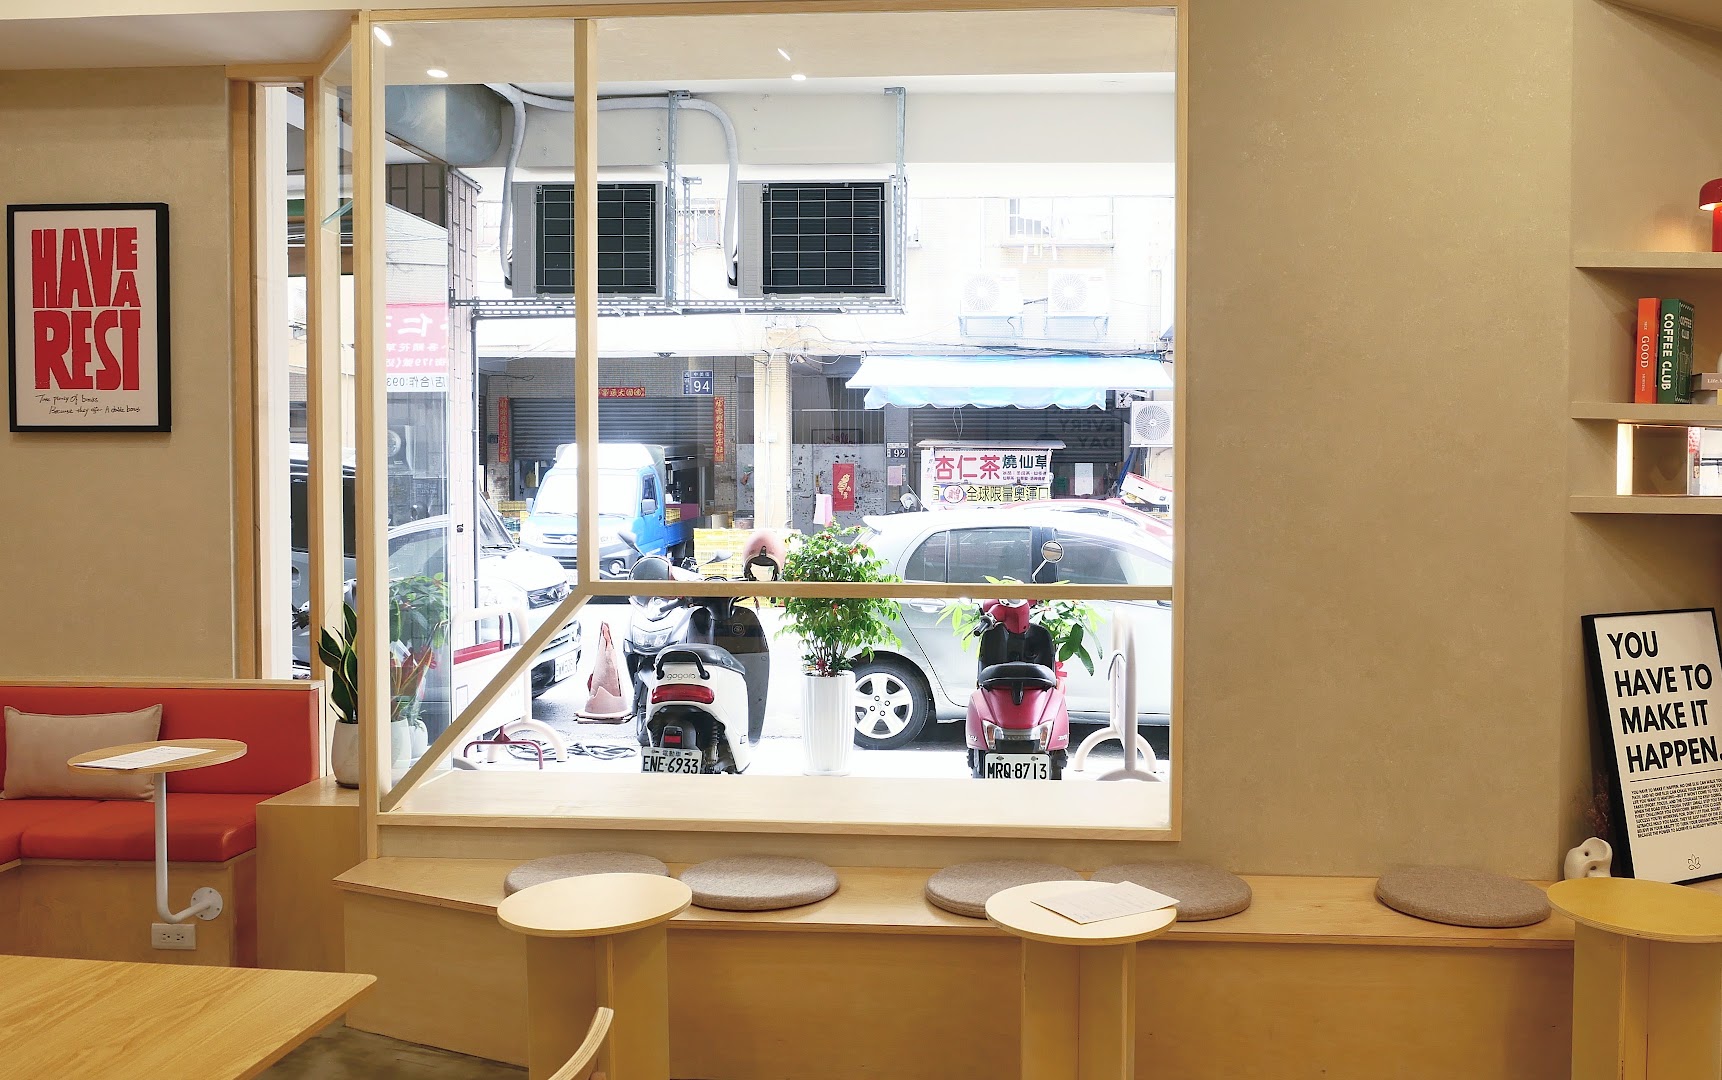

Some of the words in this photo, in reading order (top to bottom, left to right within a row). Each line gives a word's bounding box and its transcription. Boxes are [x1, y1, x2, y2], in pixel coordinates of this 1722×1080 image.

[31, 227, 138, 308] HAVE
[111, 271, 141, 307] A
[33, 309, 141, 391] REST
[1640, 336, 1650, 368] GOOD
[1663, 314, 1674, 357] COFFEE
[694, 380, 710, 392] 94
[1662, 361, 1672, 390] CLUB
[894, 448, 906, 458] 92
[934, 454, 1000, 480] 杏仁茶
[1002, 454, 1047, 470] 燒仙草
[1606, 630, 1658, 660] YOU
[1614, 666, 1678, 698] HAVE
[1680, 663, 1712, 691] TO
[1620, 702, 1688, 734] MAKE
[1690, 700, 1708, 727] IT
[1626, 736, 1722, 774] HAPPEN.
